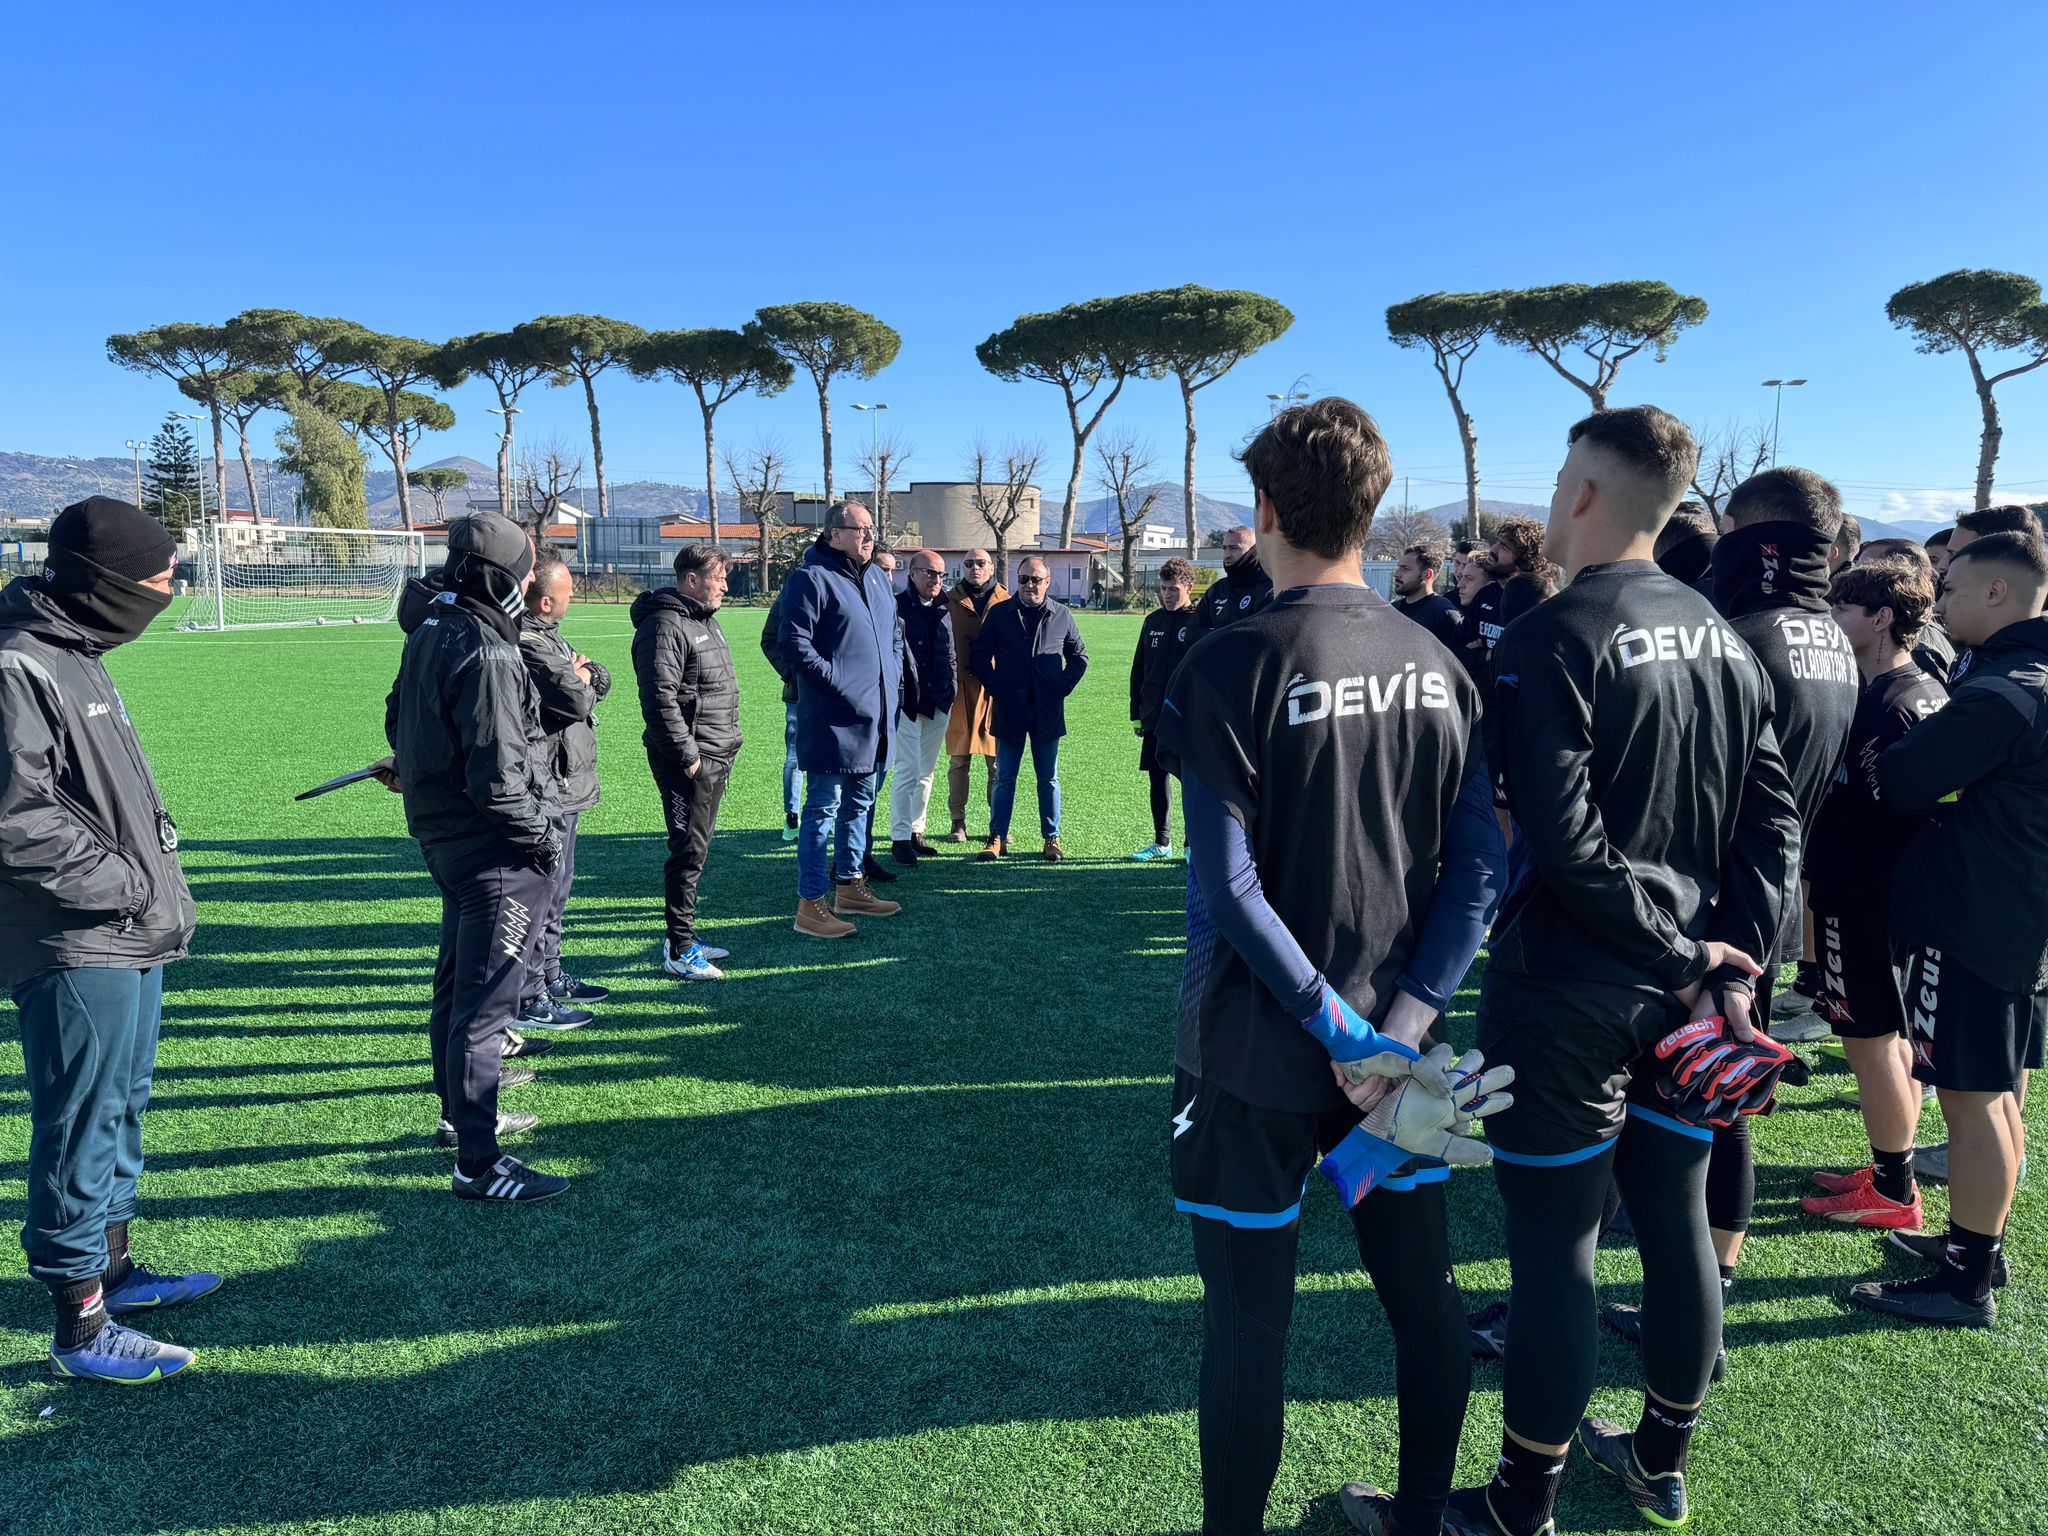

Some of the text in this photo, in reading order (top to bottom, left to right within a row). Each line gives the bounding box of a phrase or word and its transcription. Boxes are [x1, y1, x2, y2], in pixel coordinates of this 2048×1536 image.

[1215, 606, 1224, 615] 7
[1151, 637, 1159, 648] 15
[1788, 648, 1848, 683] GLADIATOR
[1825, 917, 1847, 998] Zeus
[1914, 946, 1942, 1041] Zeus
[1660, 1018, 1715, 1053] reusch
